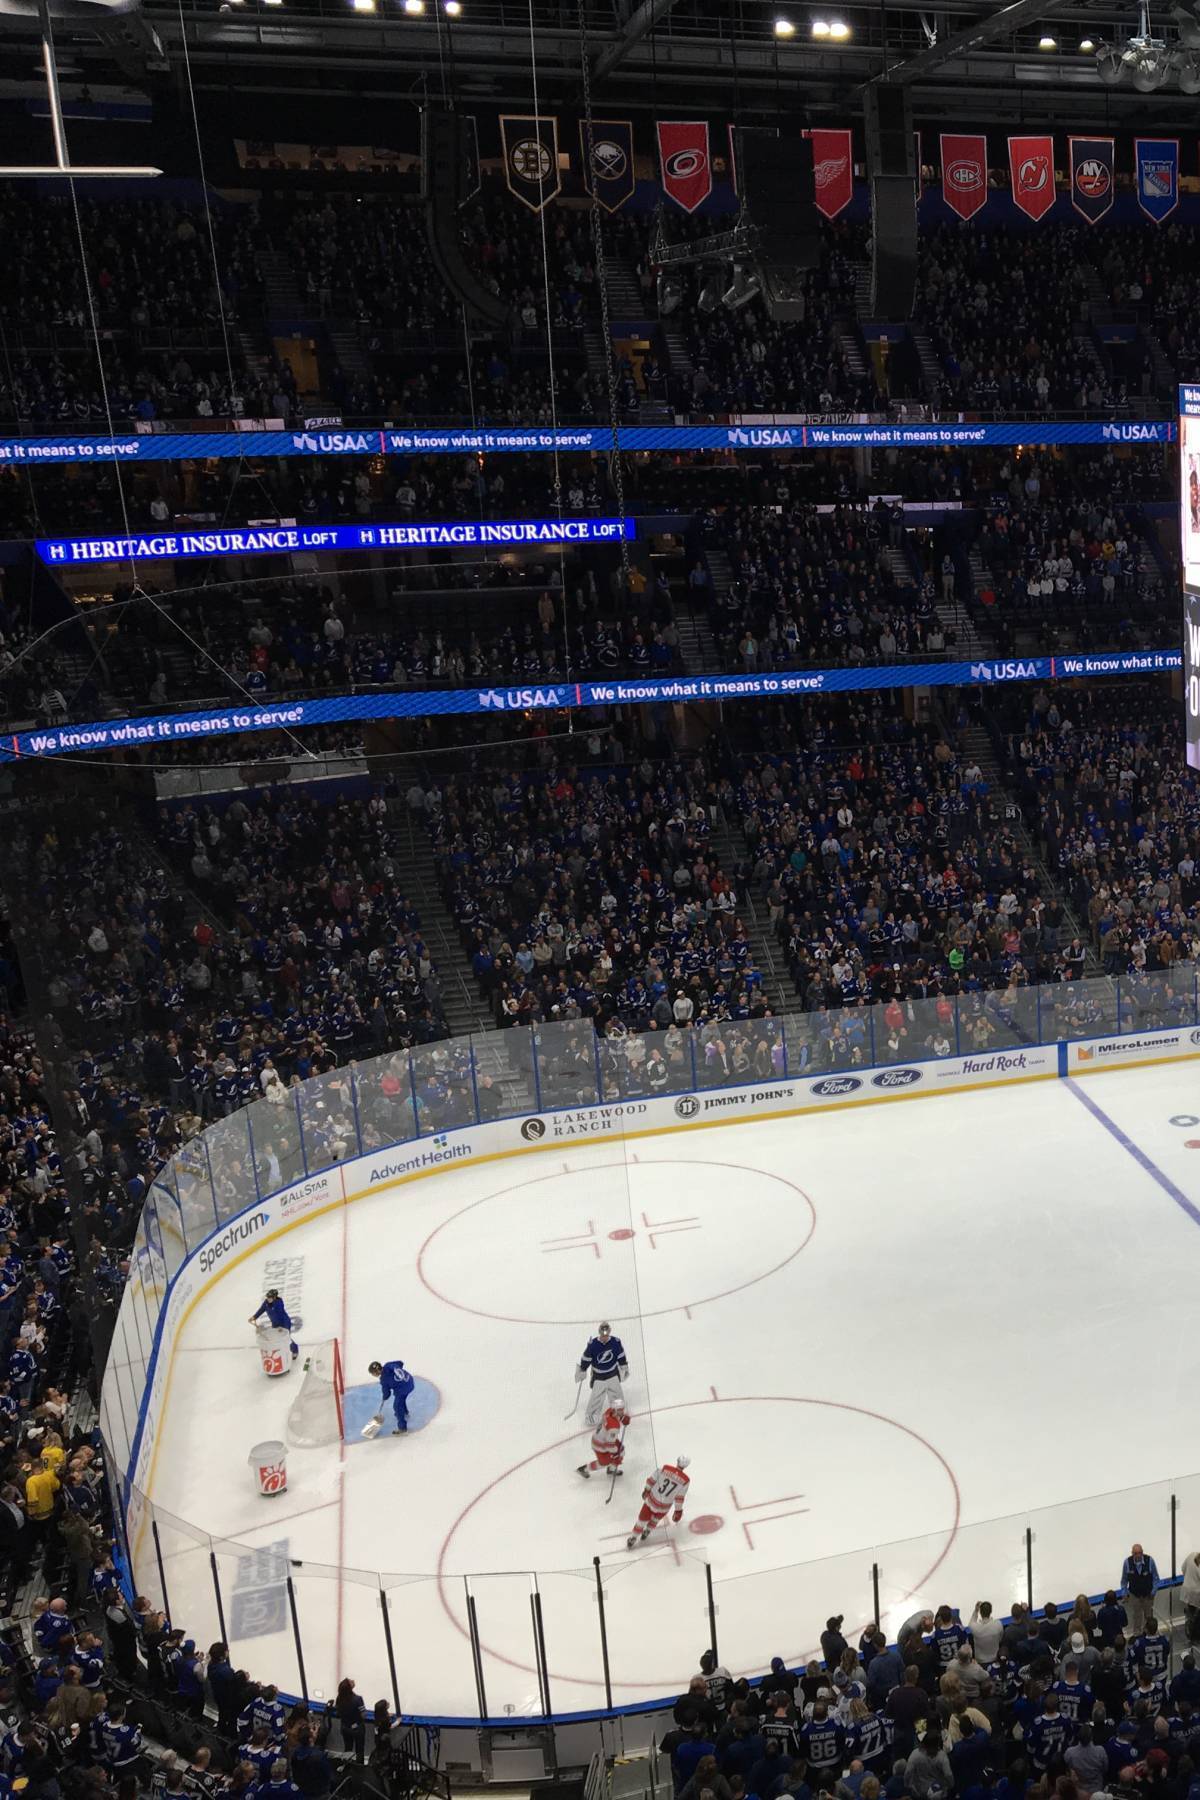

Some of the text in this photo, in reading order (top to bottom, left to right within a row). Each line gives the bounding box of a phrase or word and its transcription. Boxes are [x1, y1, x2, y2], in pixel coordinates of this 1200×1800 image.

[391, 436, 411, 448] We
[413, 435, 448, 447] know
[451, 435, 483, 446] what
[485, 434, 494, 446] it
[497, 435, 536, 446] means
[539, 435, 552, 445] to
[812, 430, 830, 442] We
[832, 430, 861, 442] know
[863, 430, 892, 441] what
[893, 429, 901, 440] it
[903, 431, 937, 441] means
[940, 430, 951, 440] to
[14, 443, 25, 457] it
[28, 444, 75, 457] means
[78, 444, 93, 455] to
[380, 522, 624, 544] HERITAGE INSURANCE LOFT
[71, 531, 338, 560] HERITAGE INSURANCE LOFT
[1064, 660, 1083, 673] We
[1086, 658, 1120, 672] know
[1122, 655, 1152, 669] what
[1155, 655, 1164, 668] it
[591, 687, 614, 701] We
[618, 684, 658, 699] know
[661, 681, 698, 696] what
[701, 680, 711, 694] it
[714, 680, 761, 694] means
[764, 678, 778, 690] to
[31, 735, 56, 751] We
[59, 731, 106, 748] know
[111, 725, 154, 743] what
[158, 721, 171, 736] it
[175, 717, 229, 734] means
[233, 714, 251, 728] to
[1098, 1036, 1180, 1053] MicroLumen
[962, 1057, 995, 1074] Hard
[996, 1054, 1027, 1071] Rock
[820, 1079, 852, 1095] Ford
[881, 1070, 913, 1087] Ford
[704, 1088, 794, 1110] JIMMY JOHN'S
[552, 1104, 647, 1125] LAKEWOOD
[554, 1120, 612, 1137] RANCH
[369, 1144, 471, 1182] AdventHealth
[199, 1212, 265, 1273] Spectrum
[658, 1477, 679, 1498] 37
[809, 1739, 837, 1761] 86
